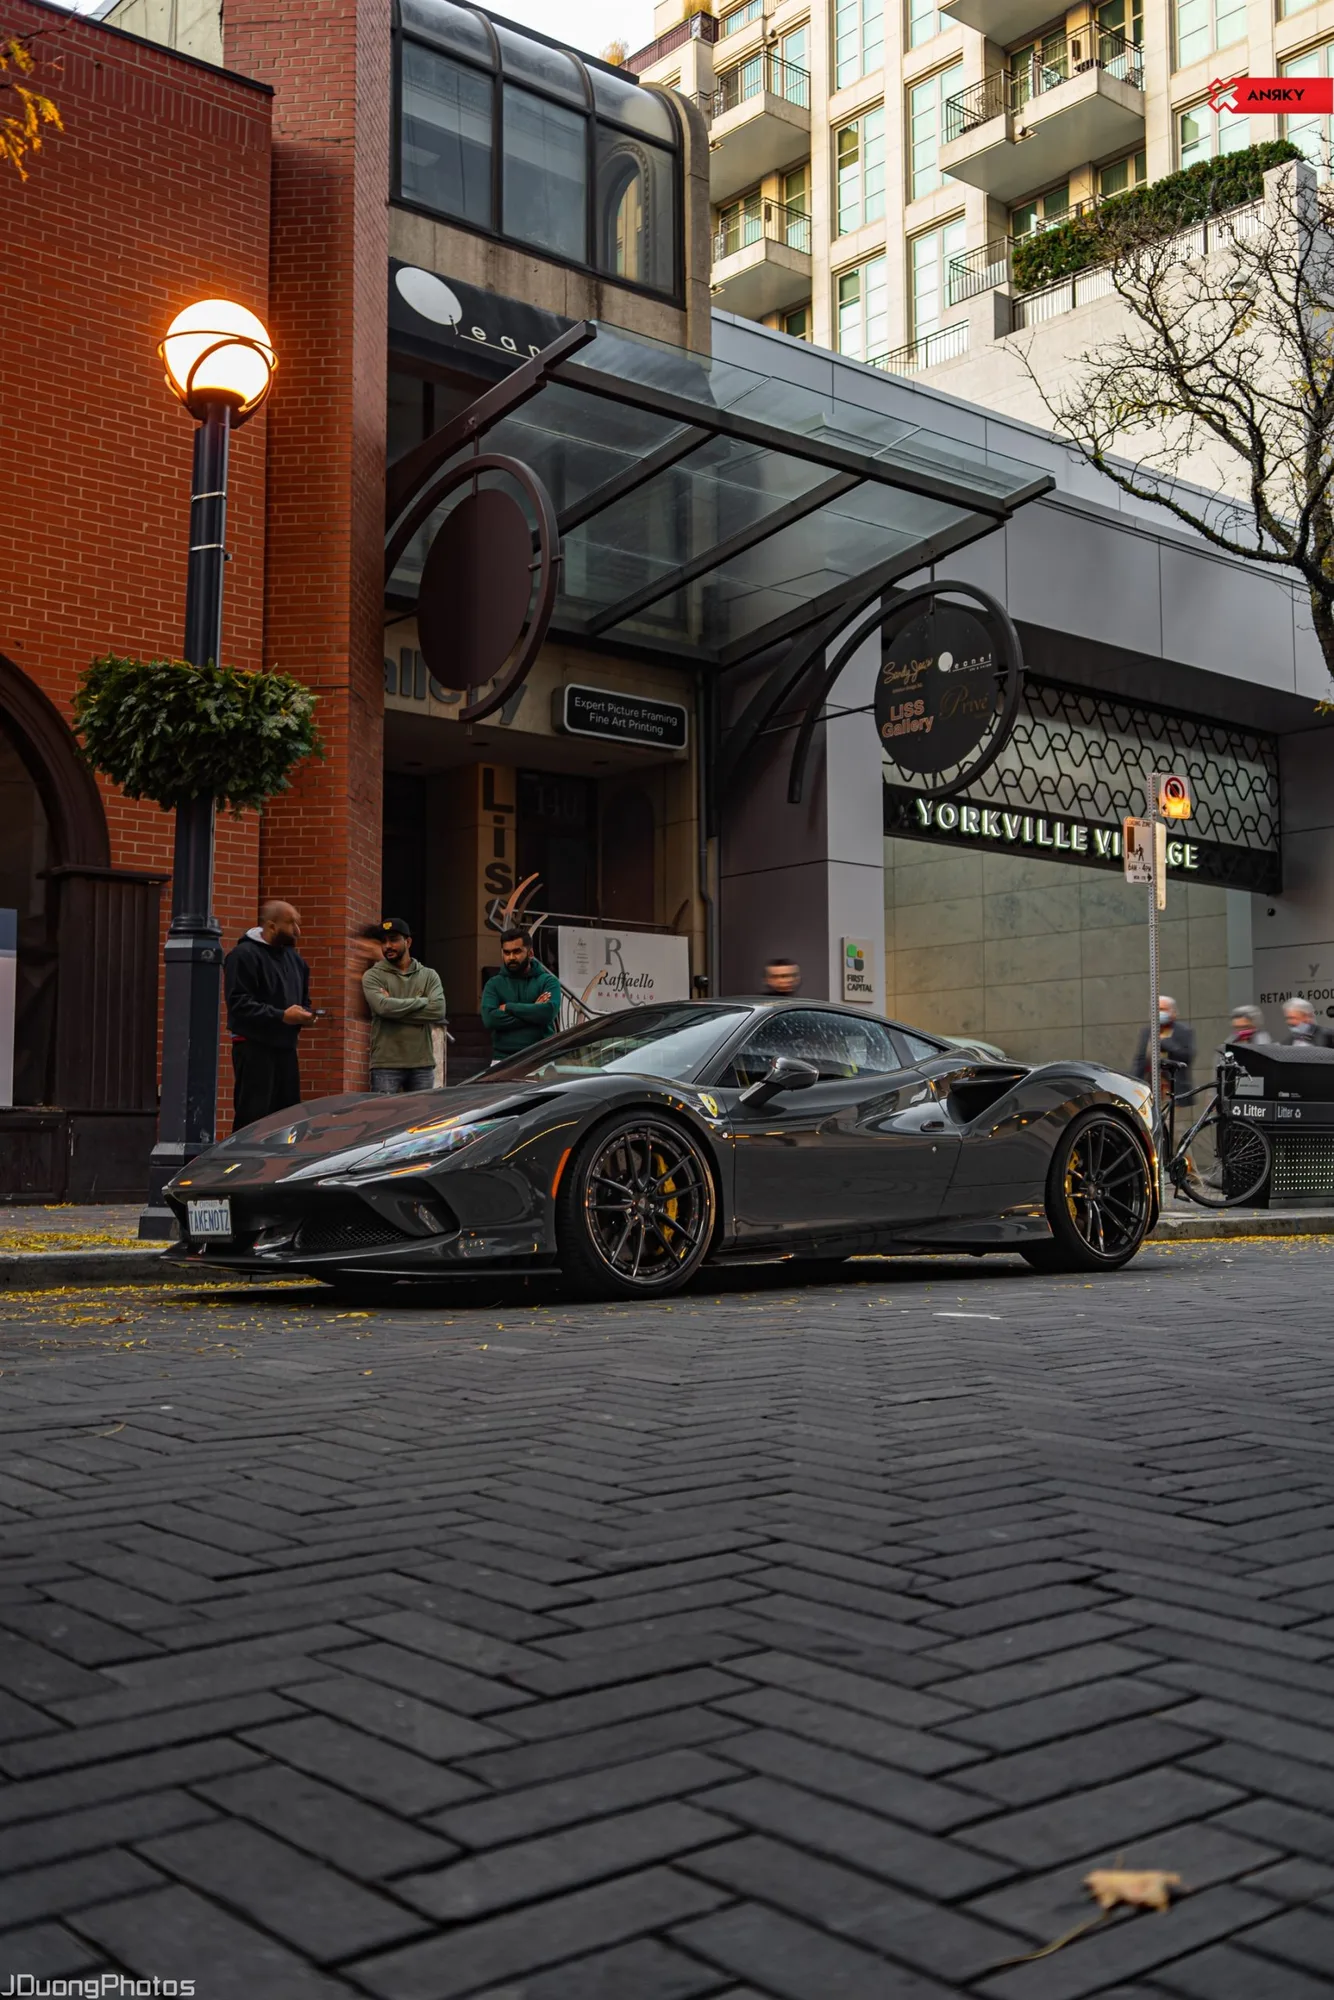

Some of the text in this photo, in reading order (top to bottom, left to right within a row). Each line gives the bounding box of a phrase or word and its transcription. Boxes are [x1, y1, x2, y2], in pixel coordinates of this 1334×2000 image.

[574, 696, 678, 726] Expert Picture Framing
[589, 712, 664, 735] Fine Art Printing
[882, 716, 934, 738] Gallery
[916, 798, 1200, 870] YORKVILLE VIGE
[598, 971, 655, 992] Raffaello
[846, 974, 865, 983] FIRST
[846, 983, 873, 993] CAPITAL
[1243, 1103, 1267, 1118] Litter
